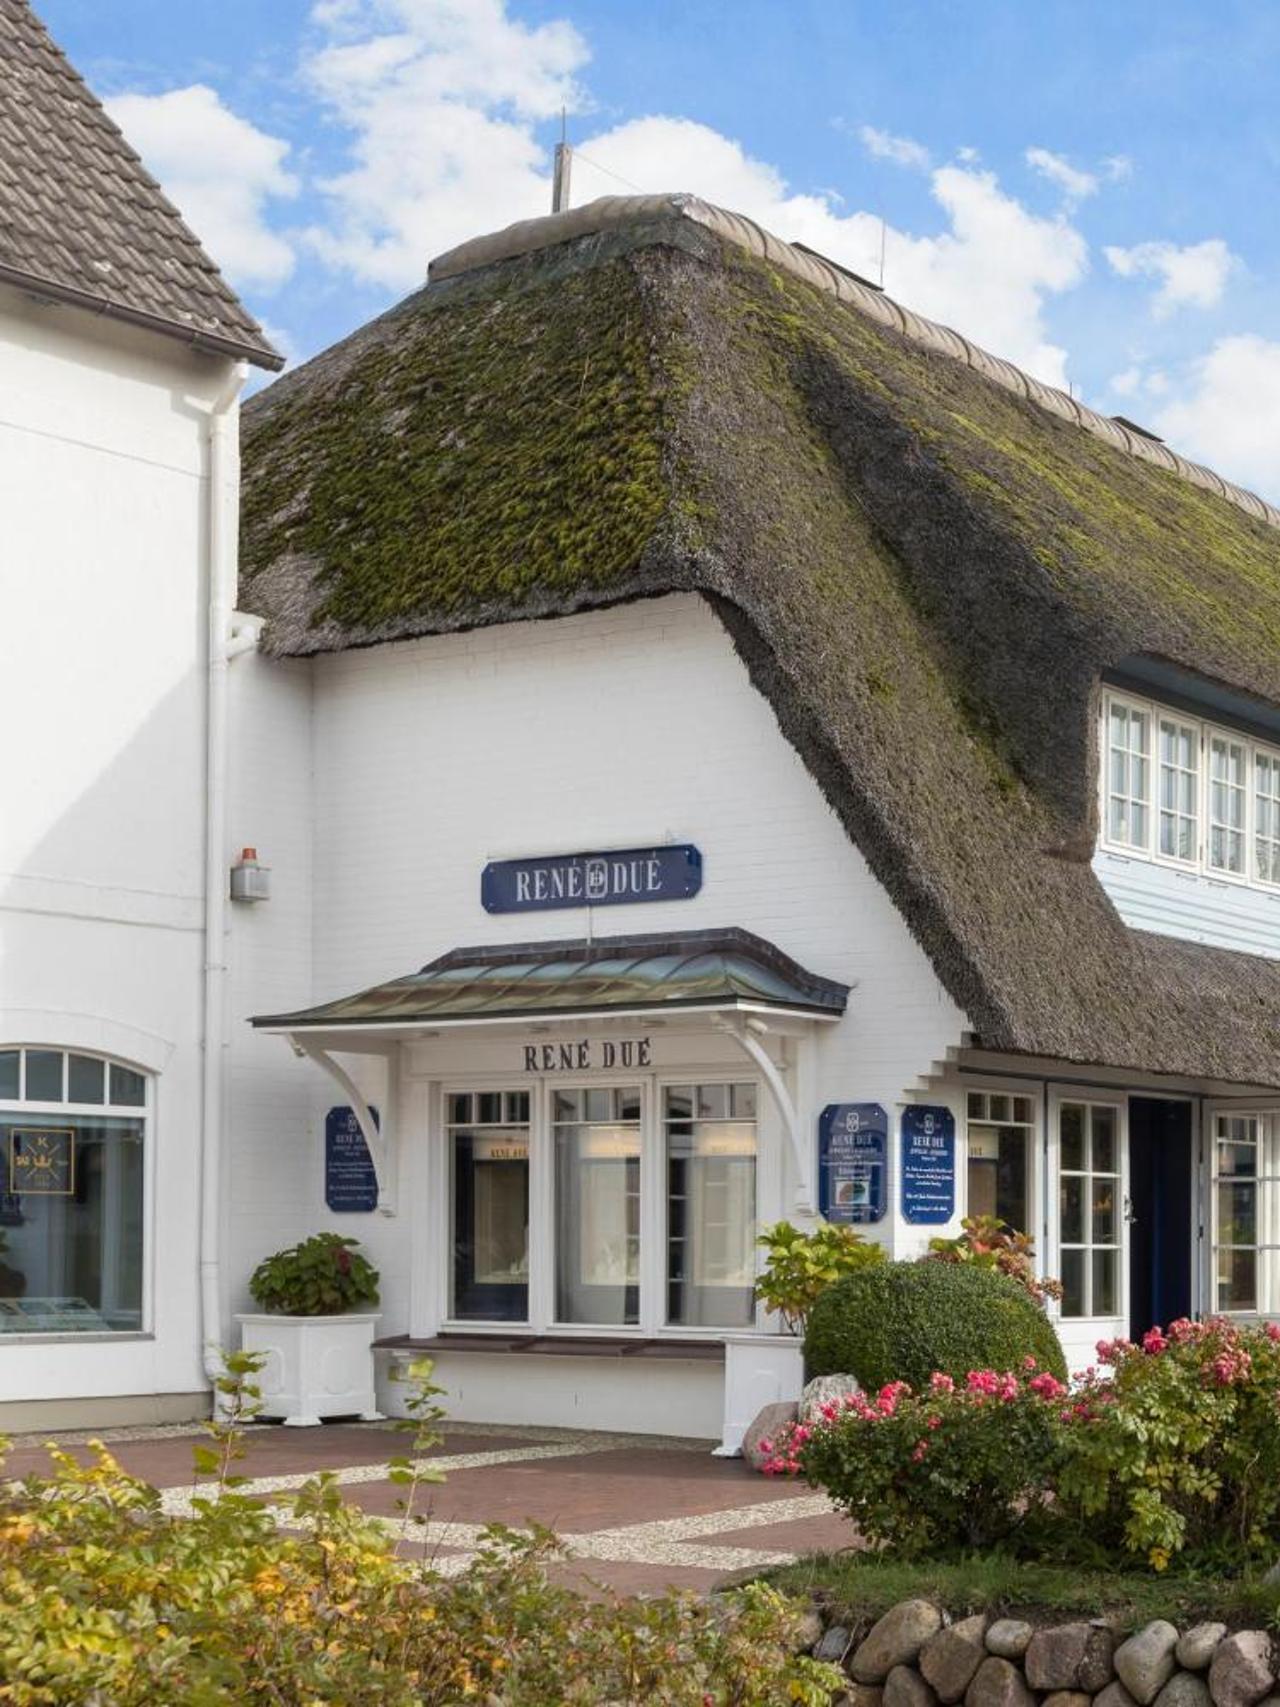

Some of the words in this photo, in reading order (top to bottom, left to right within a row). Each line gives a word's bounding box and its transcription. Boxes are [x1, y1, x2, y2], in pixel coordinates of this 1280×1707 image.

[516, 858, 583, 902] RENÉ
[613, 851, 663, 894] DUÉ
[523, 1038, 591, 1072] RENÉ
[603, 1036, 652, 1068] DUÉ
